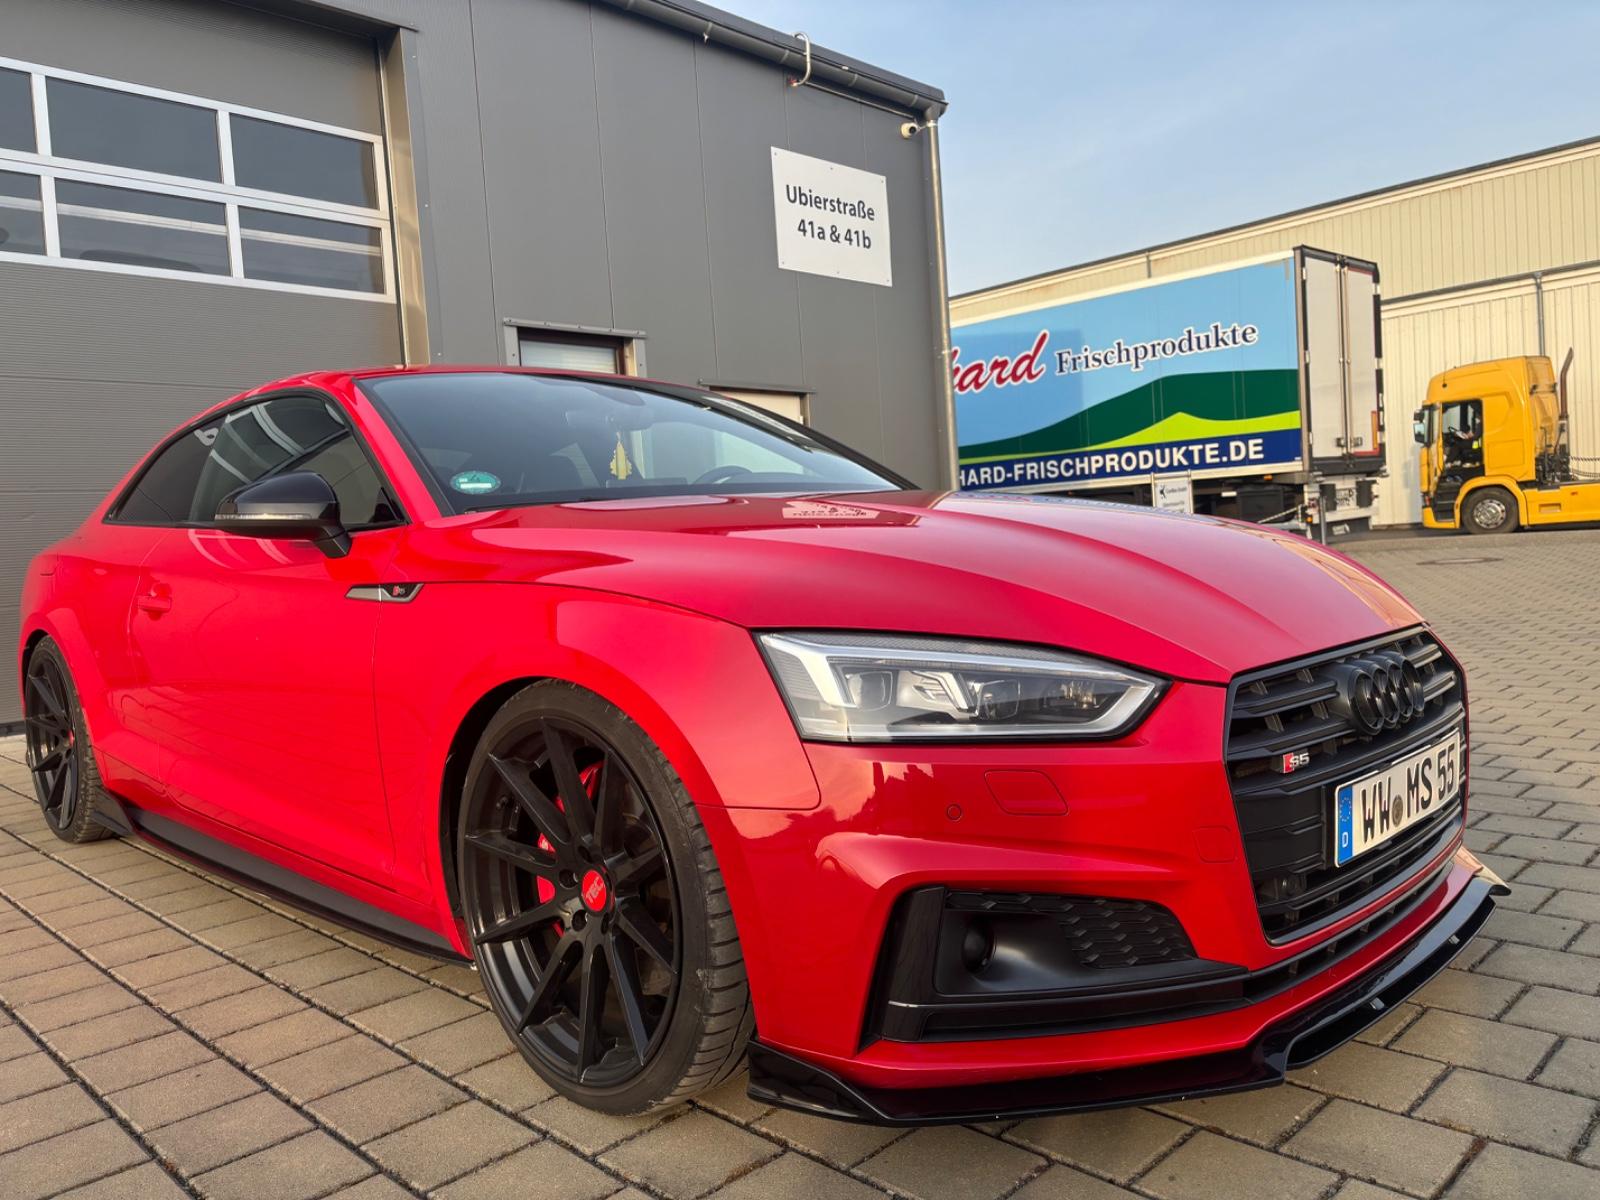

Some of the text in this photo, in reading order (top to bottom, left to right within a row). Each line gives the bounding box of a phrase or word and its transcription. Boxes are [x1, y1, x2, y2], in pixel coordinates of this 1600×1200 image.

[786, 184, 875, 221] Ubierstraße
[797, 219, 871, 249] 41a & 41b
[1056, 323, 1258, 374] Frischprodukte
[1361, 742, 1455, 843] WW MS 55
[1341, 831, 1349, 848] D
